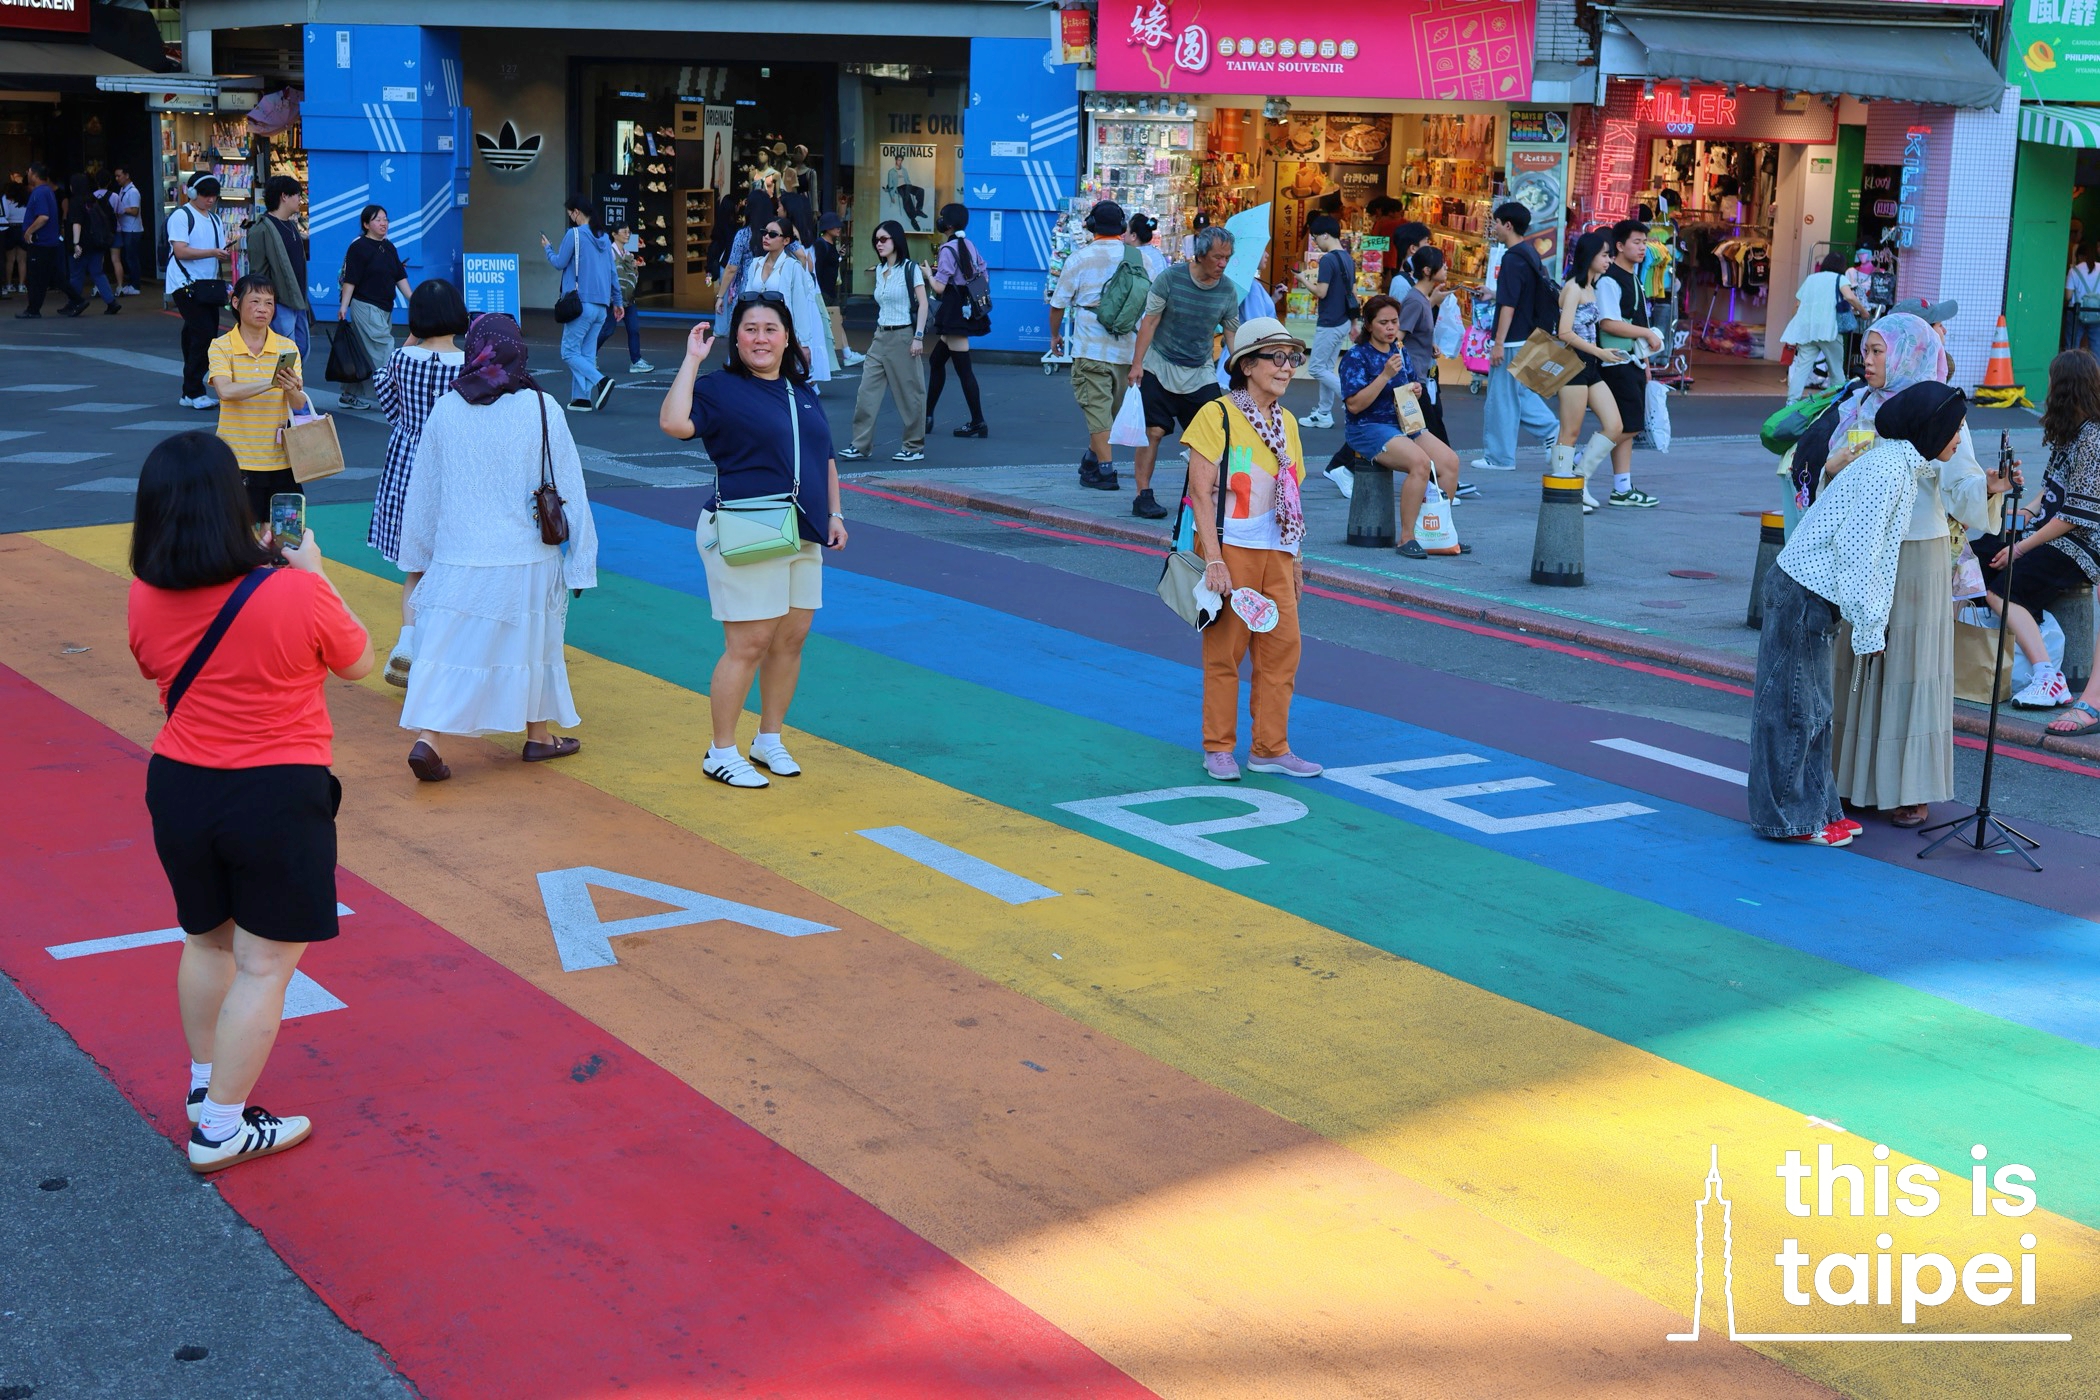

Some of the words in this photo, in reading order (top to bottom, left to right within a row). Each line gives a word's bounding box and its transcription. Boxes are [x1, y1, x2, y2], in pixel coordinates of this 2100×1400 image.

[1218, 38, 1357, 58] 台灣紀念禮品館
[1226, 60, 1274, 72] TAIWAN
[1277, 61, 1344, 74] SOUVENIR
[705, 108, 733, 127] ORIGINALS
[1635, 91, 1737, 125] KILLER
[888, 113, 922, 134] THE
[927, 113, 964, 136] ORI
[1511, 120, 1543, 141] 365
[882, 146, 934, 158] ORIGINALS
[466, 258, 516, 271] OPENING
[467, 271, 505, 284] HOURS
